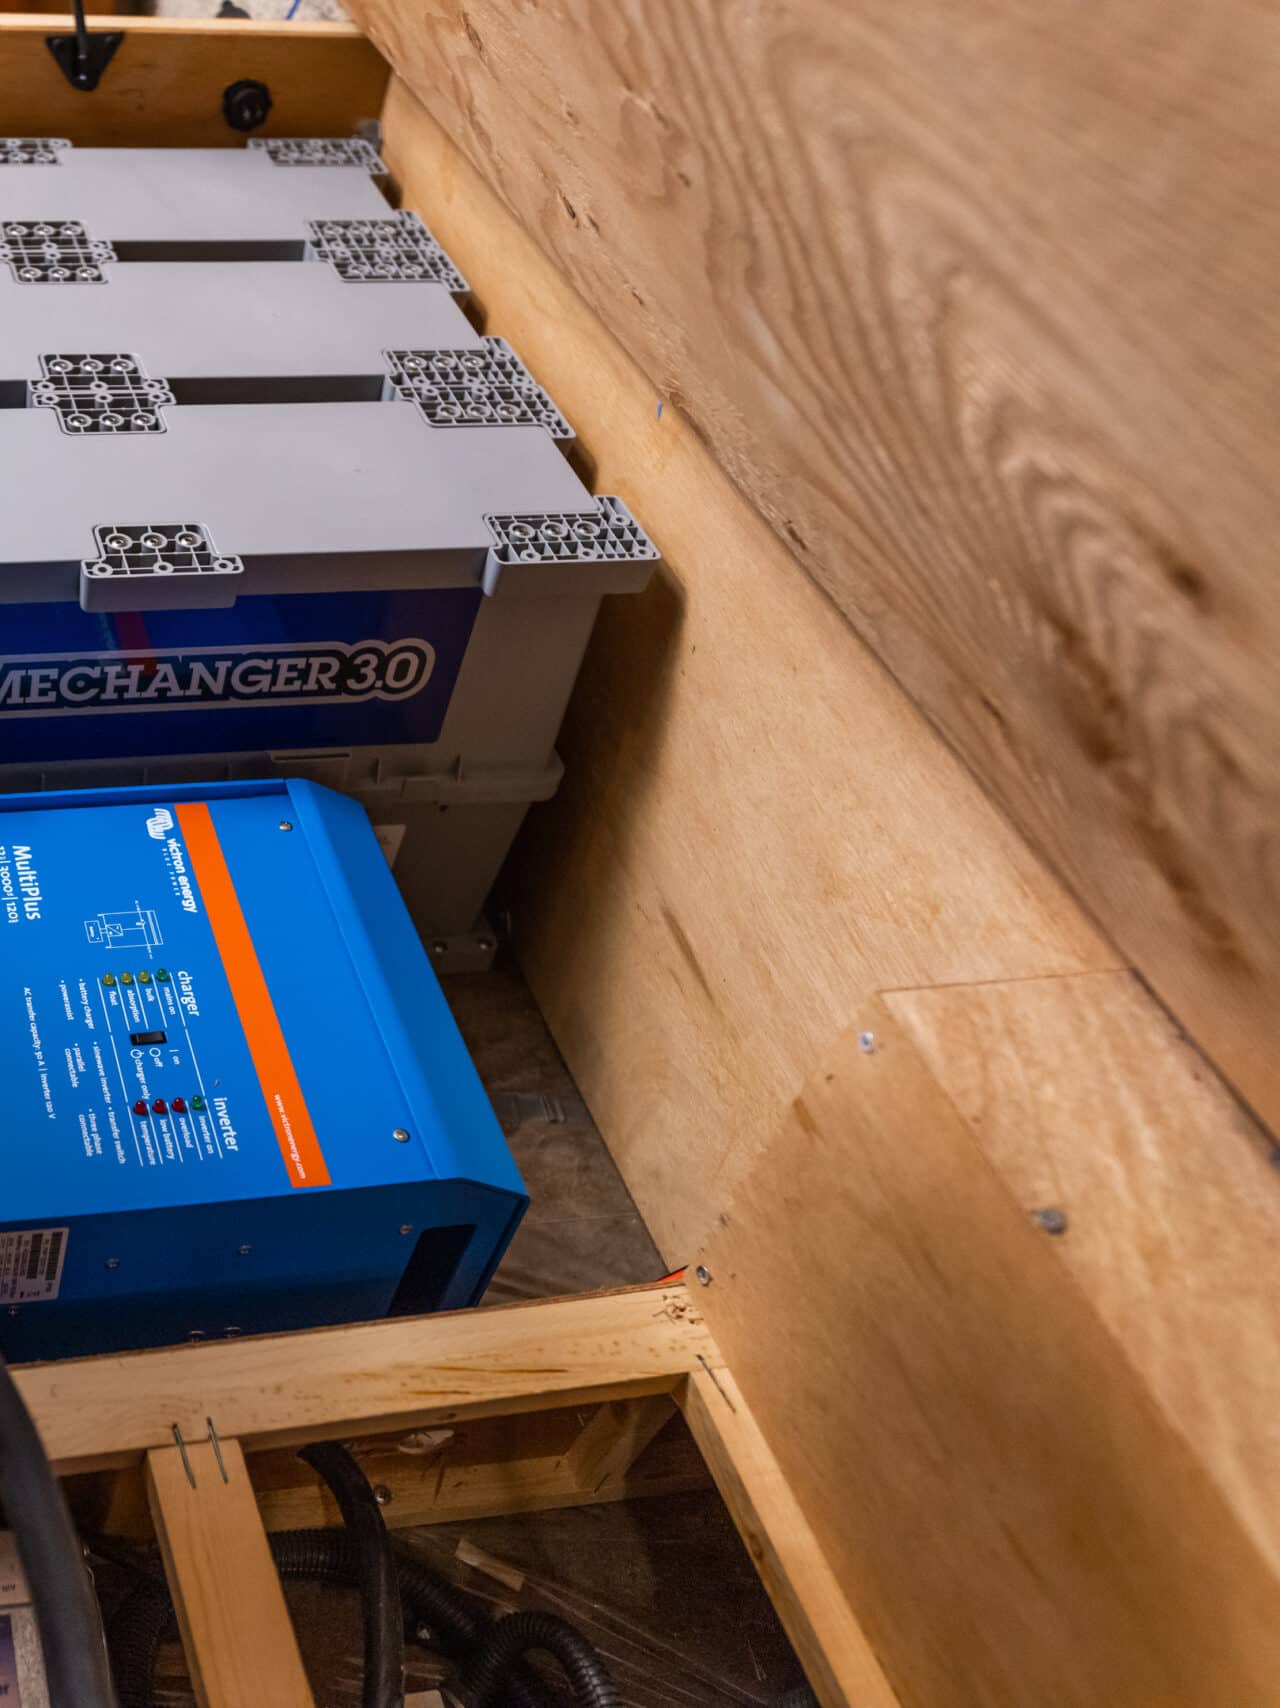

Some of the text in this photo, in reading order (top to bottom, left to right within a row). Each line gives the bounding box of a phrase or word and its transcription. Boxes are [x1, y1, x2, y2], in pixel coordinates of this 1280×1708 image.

[345, 651, 421, 690] 3.0
[12, 845, 43, 920] MultiPlus
[167, 838, 197, 913] victron energy
[24, 987, 32, 996] AC
[25, 996, 36, 1022] transfer
[59, 984, 74, 1020] powerassist
[78, 982, 94, 1029] battery charger
[109, 990, 118, 1006] float
[127, 989, 140, 1023] absorption
[145, 988, 155, 1002] bulk
[164, 987, 176, 1015] mains on
[177, 971, 199, 1016] charger
[30, 1022, 41, 1050] capacity:
[64, 1048, 79, 1088] connectable
[72, 1047, 86, 1072] parallel
[93, 1046, 111, 1104] sinewave inverter
[135, 1058, 151, 1100] charger only
[154, 1057, 163, 1067] off
[172, 1056, 180, 1065] on
[78, 1114, 94, 1157] connectable
[88, 1113, 102, 1154] three phase
[108, 1111, 126, 1164] transfer switch
[140, 1120, 156, 1165] temperature
[160, 1119, 175, 1159] low battery
[179, 1117, 194, 1148] overload
[213, 1097, 238, 1151] inverter
[274, 1094, 306, 1179] www.victronenergy.com
